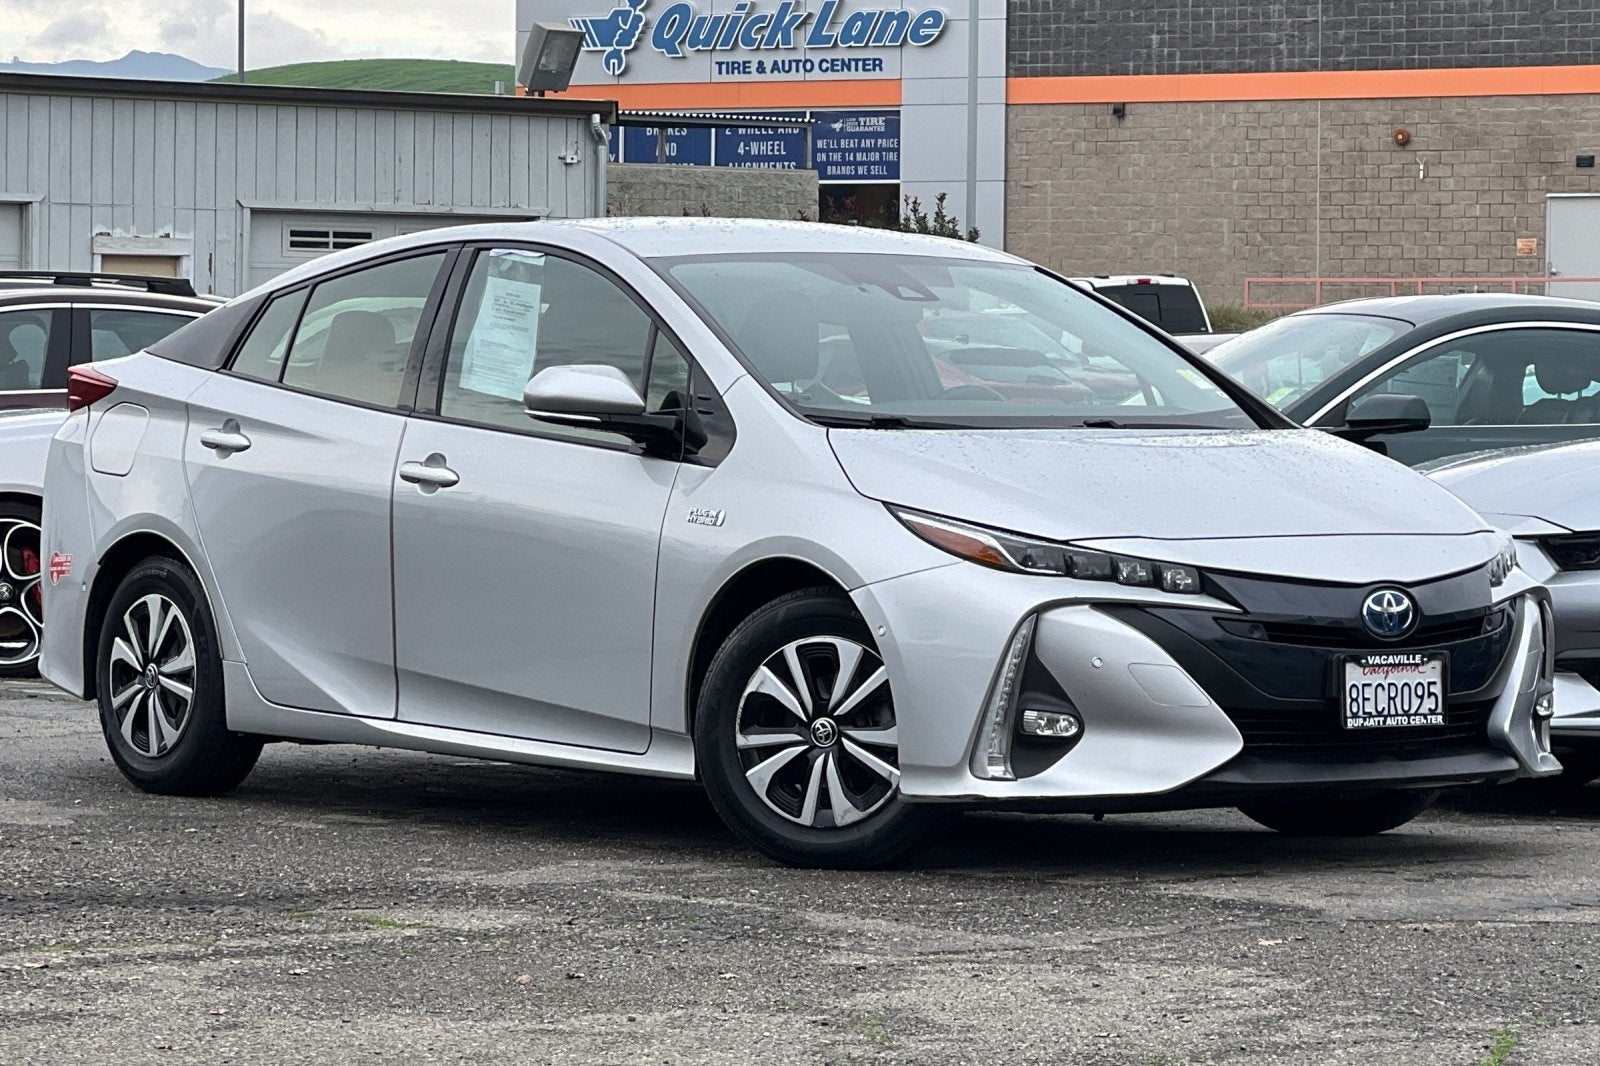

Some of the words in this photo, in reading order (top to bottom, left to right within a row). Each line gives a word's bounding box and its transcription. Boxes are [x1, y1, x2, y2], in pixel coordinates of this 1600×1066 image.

[652, 0, 806, 57] Quick
[804, 0, 945, 48] Lane
[715, 61, 751, 75] TIRE
[755, 61, 767, 74] &
[770, 60, 814, 74] AUTO
[818, 58, 883, 72] CENTER
[858, 117, 886, 126] TIRE
[737, 141, 787, 155] 4-WHEEL
[816, 139, 838, 149] WE'LL
[840, 139, 858, 149] BEAT
[860, 139, 875, 148] ANY
[877, 138, 899, 148] PRICE
[816, 153, 827, 162] ON
[829, 153, 843, 162] THE
[845, 152, 854, 162] 14
[856, 152, 880, 162] MAJOR
[882, 151, 898, 161] TIRE
[827, 166, 856, 176] BRANDS
[857, 166, 869, 175] WE
[870, 166, 888, 175] SELL
[1367, 655, 1422, 665] VACAVILLE
[1349, 681, 1438, 716] 8ECR095
[1386, 716, 1408, 726] AUTO
[1410, 715, 1443, 724] CENTER
